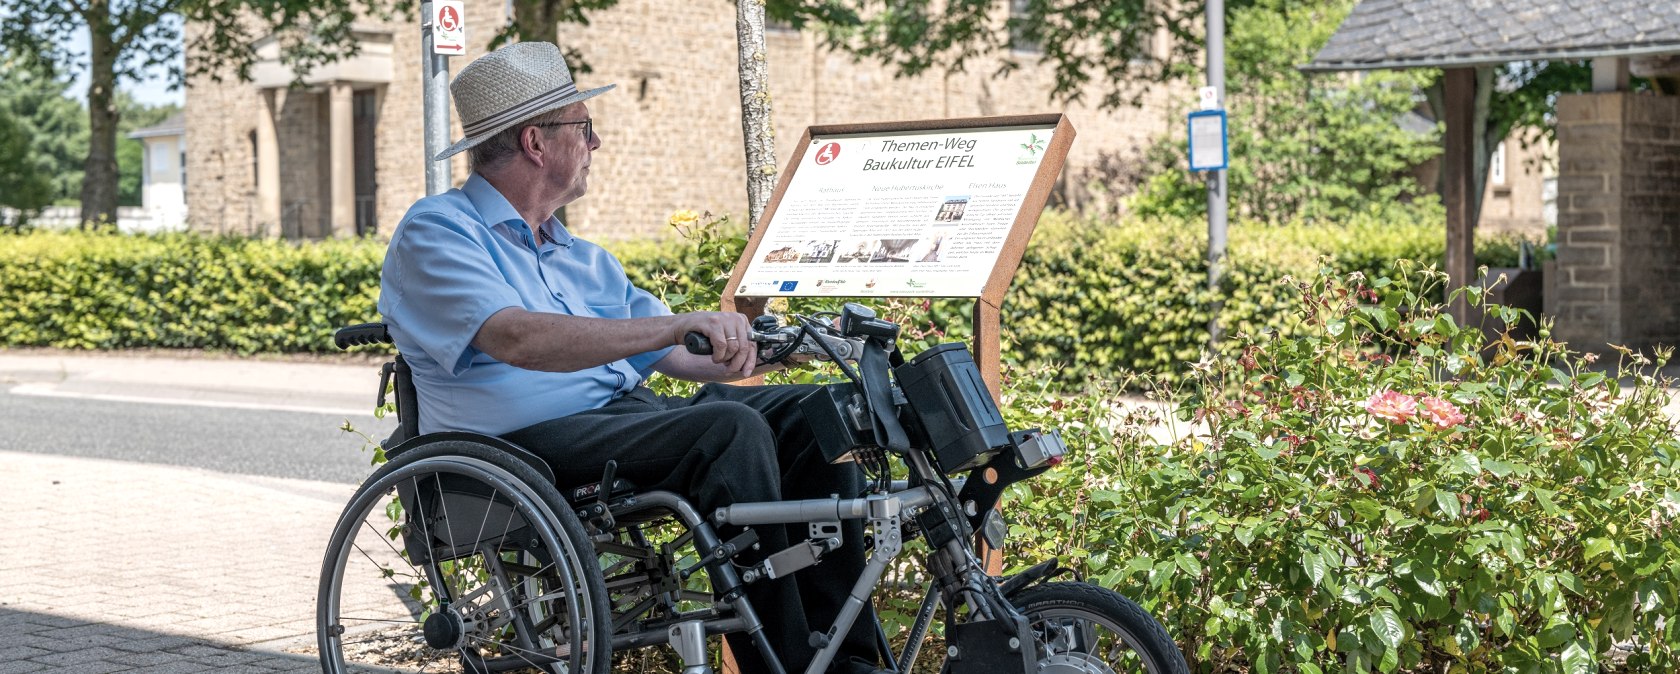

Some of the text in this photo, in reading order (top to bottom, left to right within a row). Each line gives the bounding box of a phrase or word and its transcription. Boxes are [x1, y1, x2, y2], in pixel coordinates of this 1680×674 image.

[880, 137, 977, 152] Themen-Weg
[863, 155, 975, 171] Baukultur EIFEL
